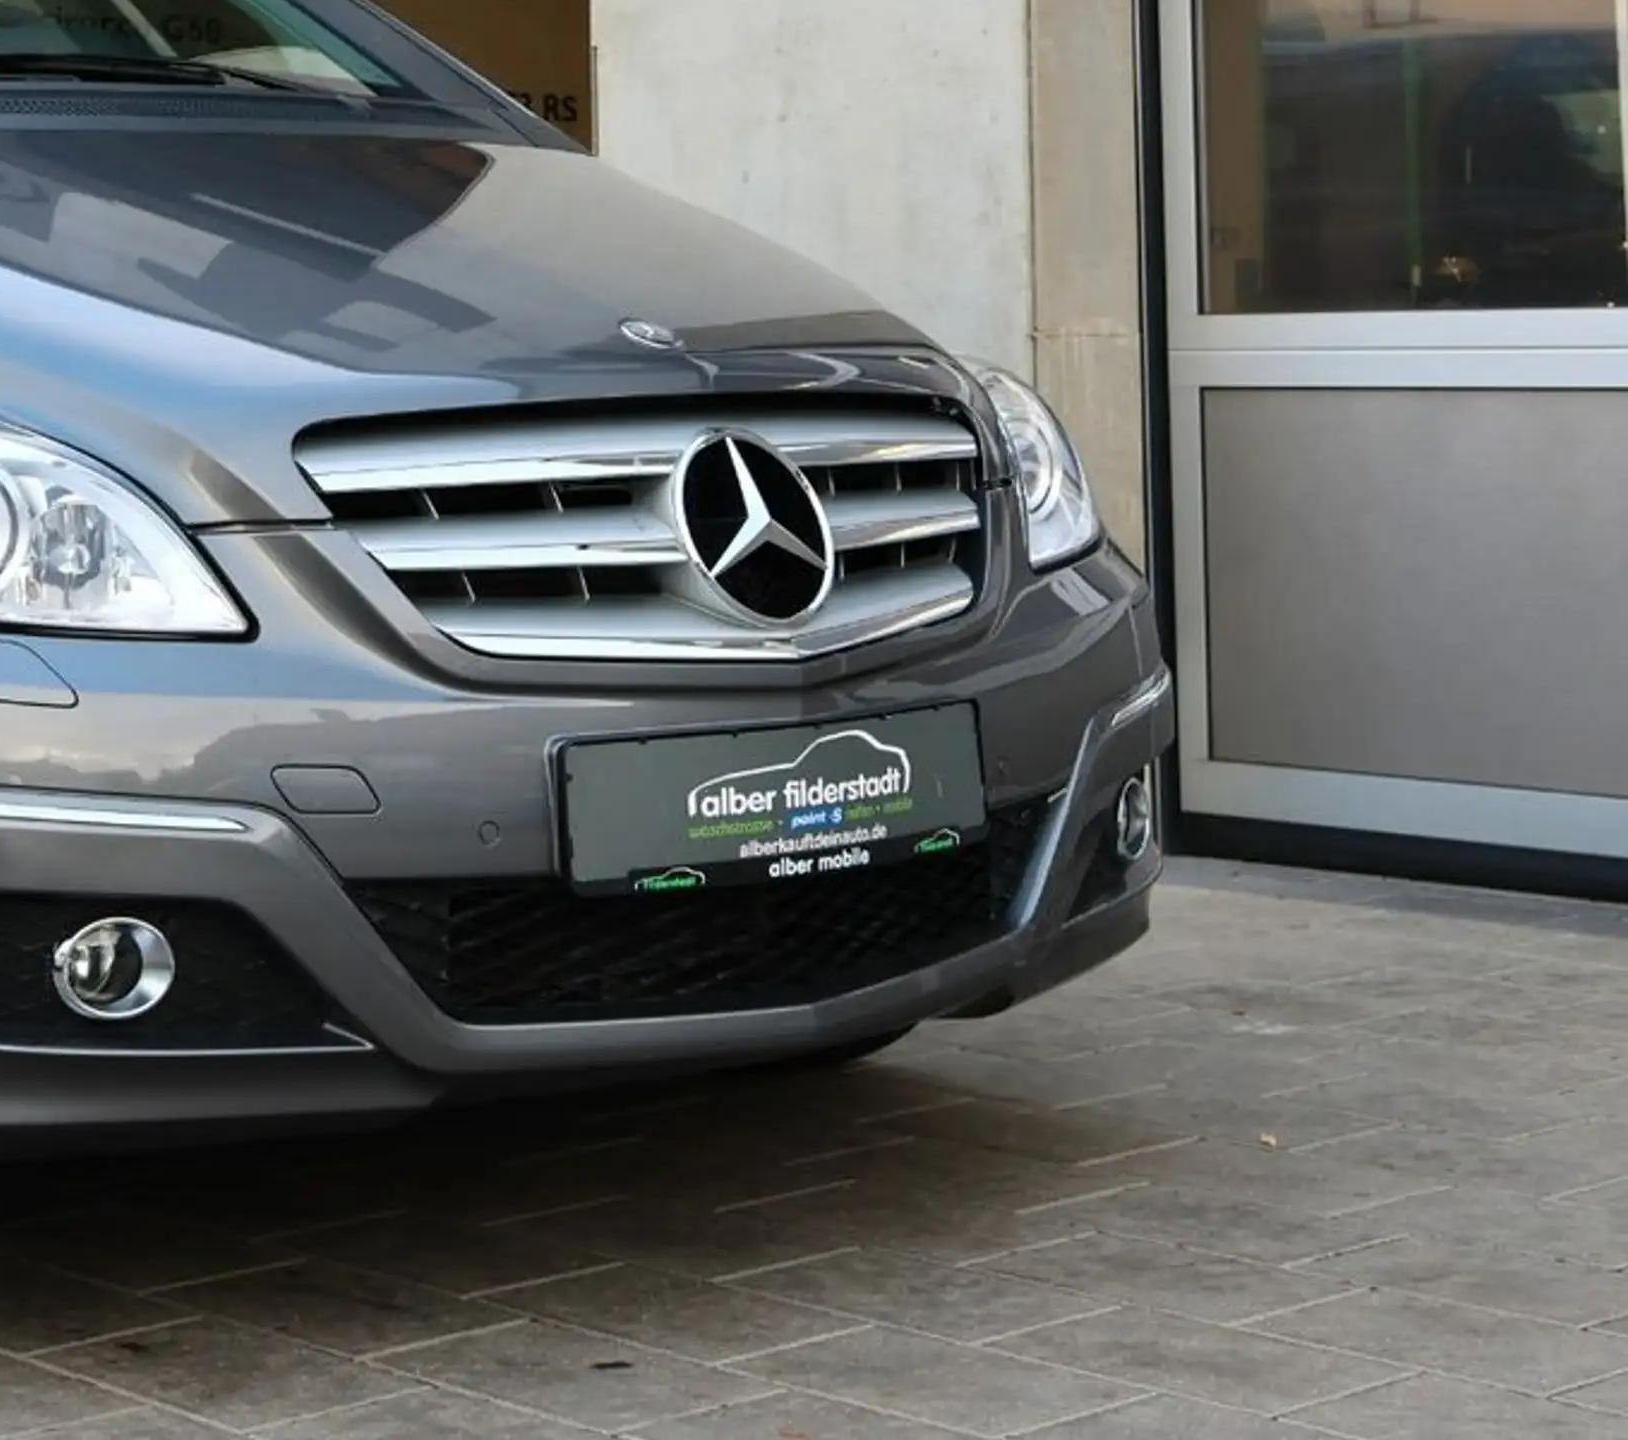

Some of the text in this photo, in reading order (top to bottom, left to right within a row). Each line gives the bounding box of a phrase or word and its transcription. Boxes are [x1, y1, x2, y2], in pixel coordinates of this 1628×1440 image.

[543, 92, 578, 121] RS
[700, 766, 902, 818] alber filderstadt
[768, 847, 871, 879] alber mobile
